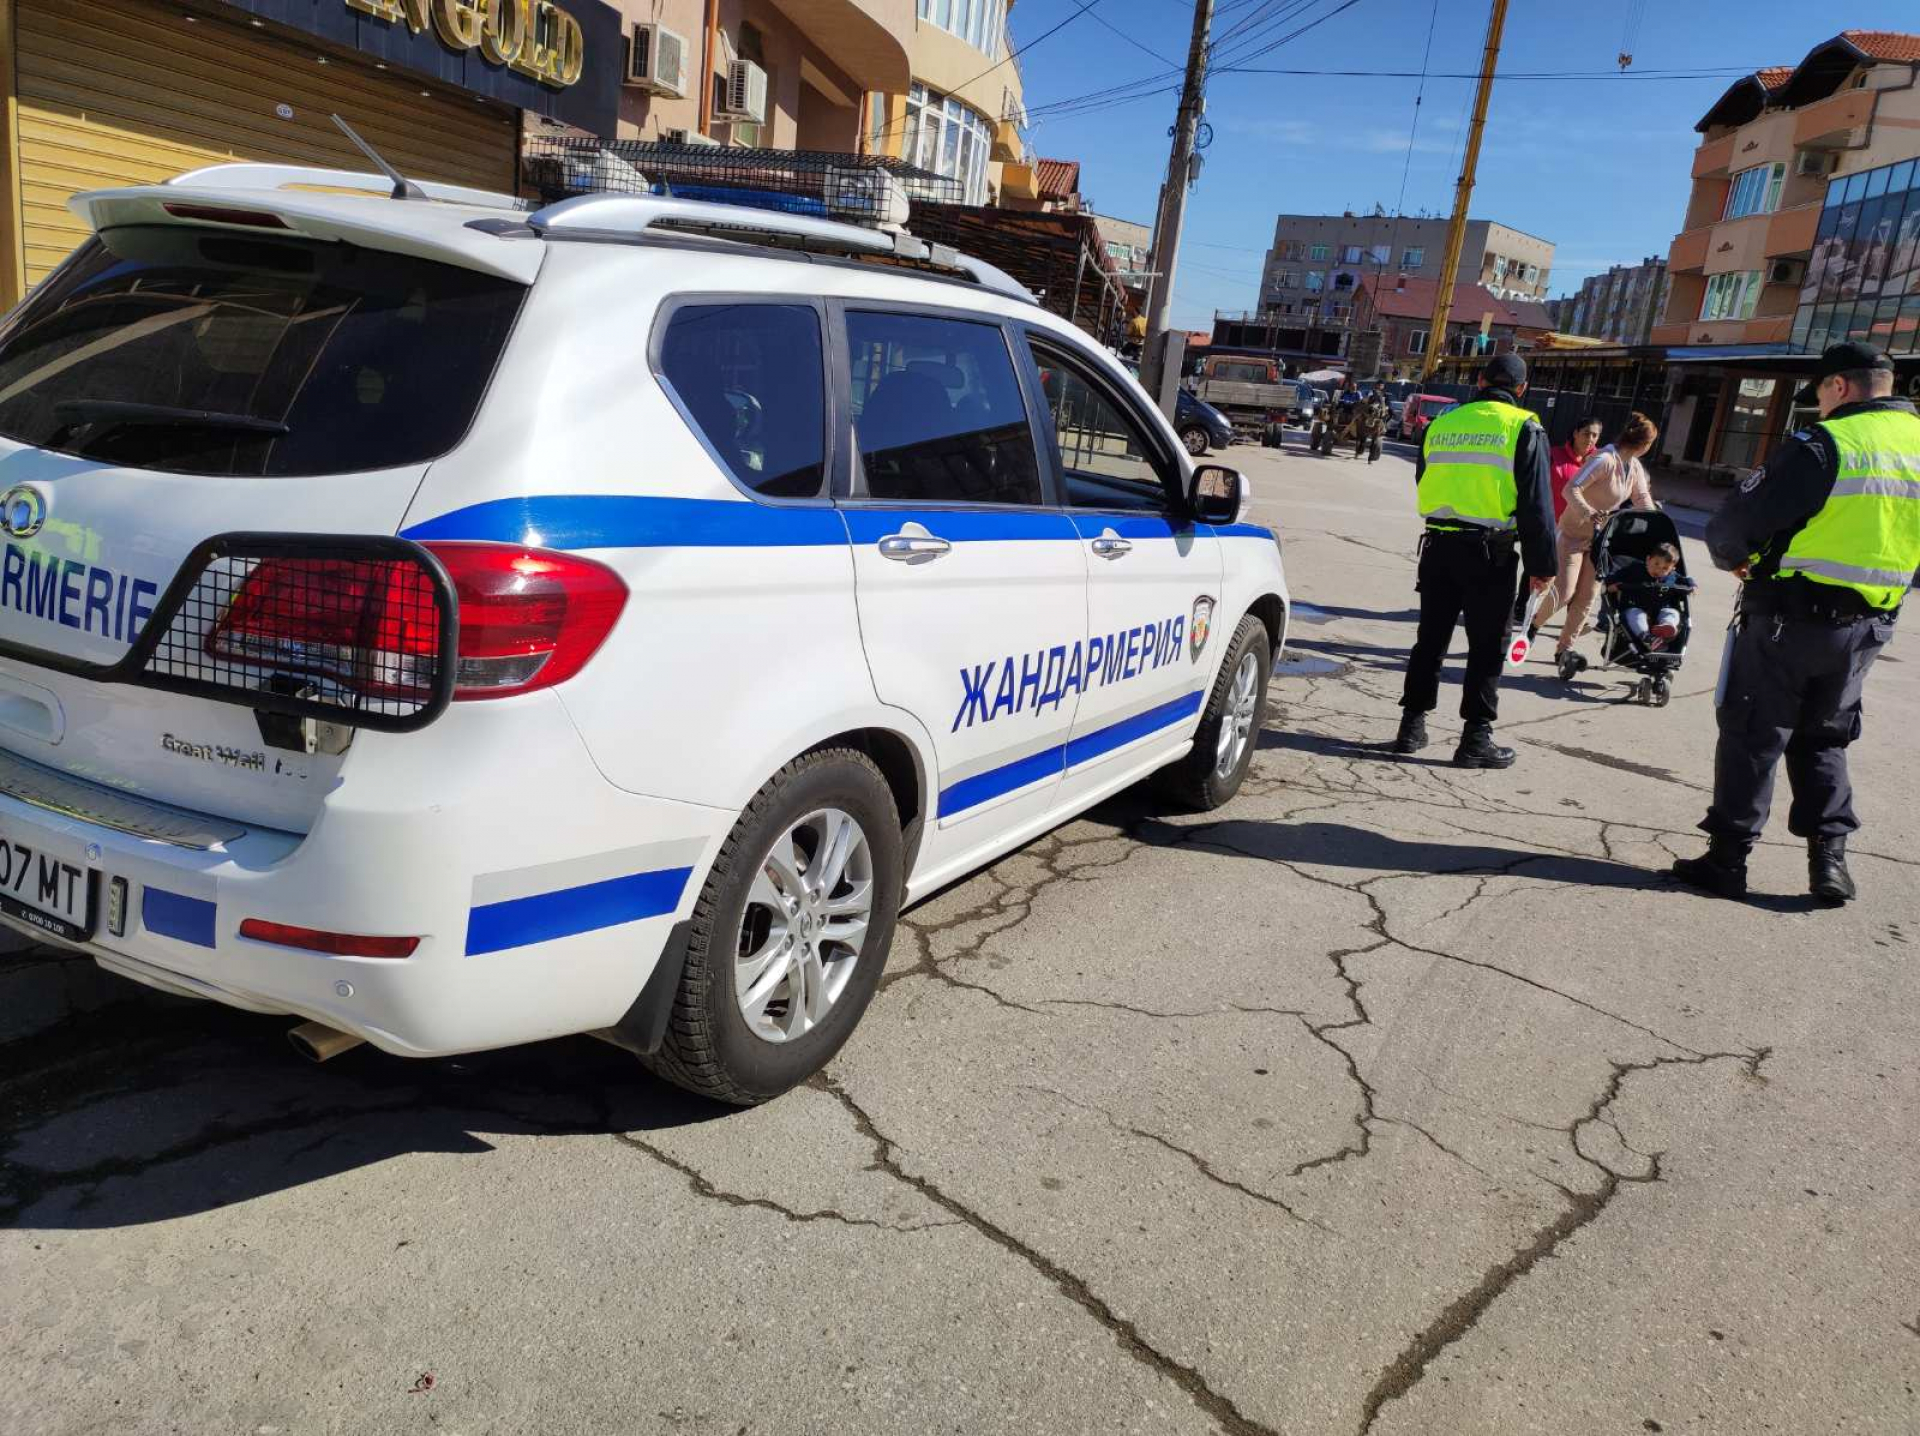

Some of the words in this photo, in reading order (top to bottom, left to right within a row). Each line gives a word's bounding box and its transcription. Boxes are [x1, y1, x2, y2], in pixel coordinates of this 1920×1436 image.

[2, 543, 157, 643] RMERIE
[951, 615, 1185, 733] ЖАНДАРМЕРИЯ
[161, 733, 213, 762] Great
[216, 744, 265, 771] Wall
[38, 854, 82, 915] MT
